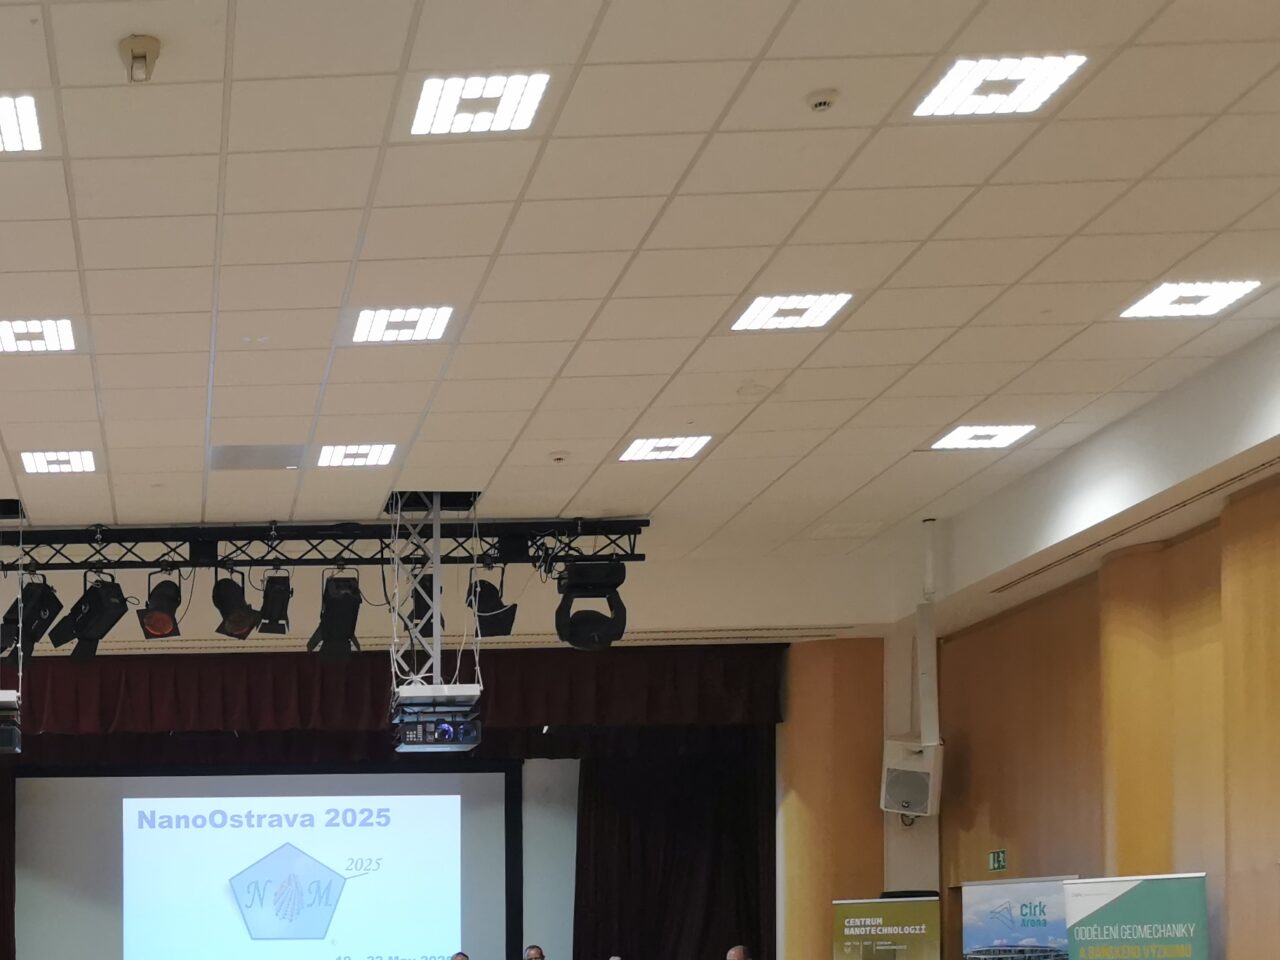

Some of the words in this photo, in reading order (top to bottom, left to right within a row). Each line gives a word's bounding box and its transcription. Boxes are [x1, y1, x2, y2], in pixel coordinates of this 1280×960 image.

[138, 810, 314, 829] NanoOstrava
[325, 808, 391, 828] 2025
[345, 858, 382, 871] 2025
[1020, 901, 1046, 916] Cirk
[845, 918, 883, 926] CENTRUM
[844, 924, 926, 935] NANOTECHNOLOGIÍ
[1120, 923, 1195, 939] GEOMECHANIKY
